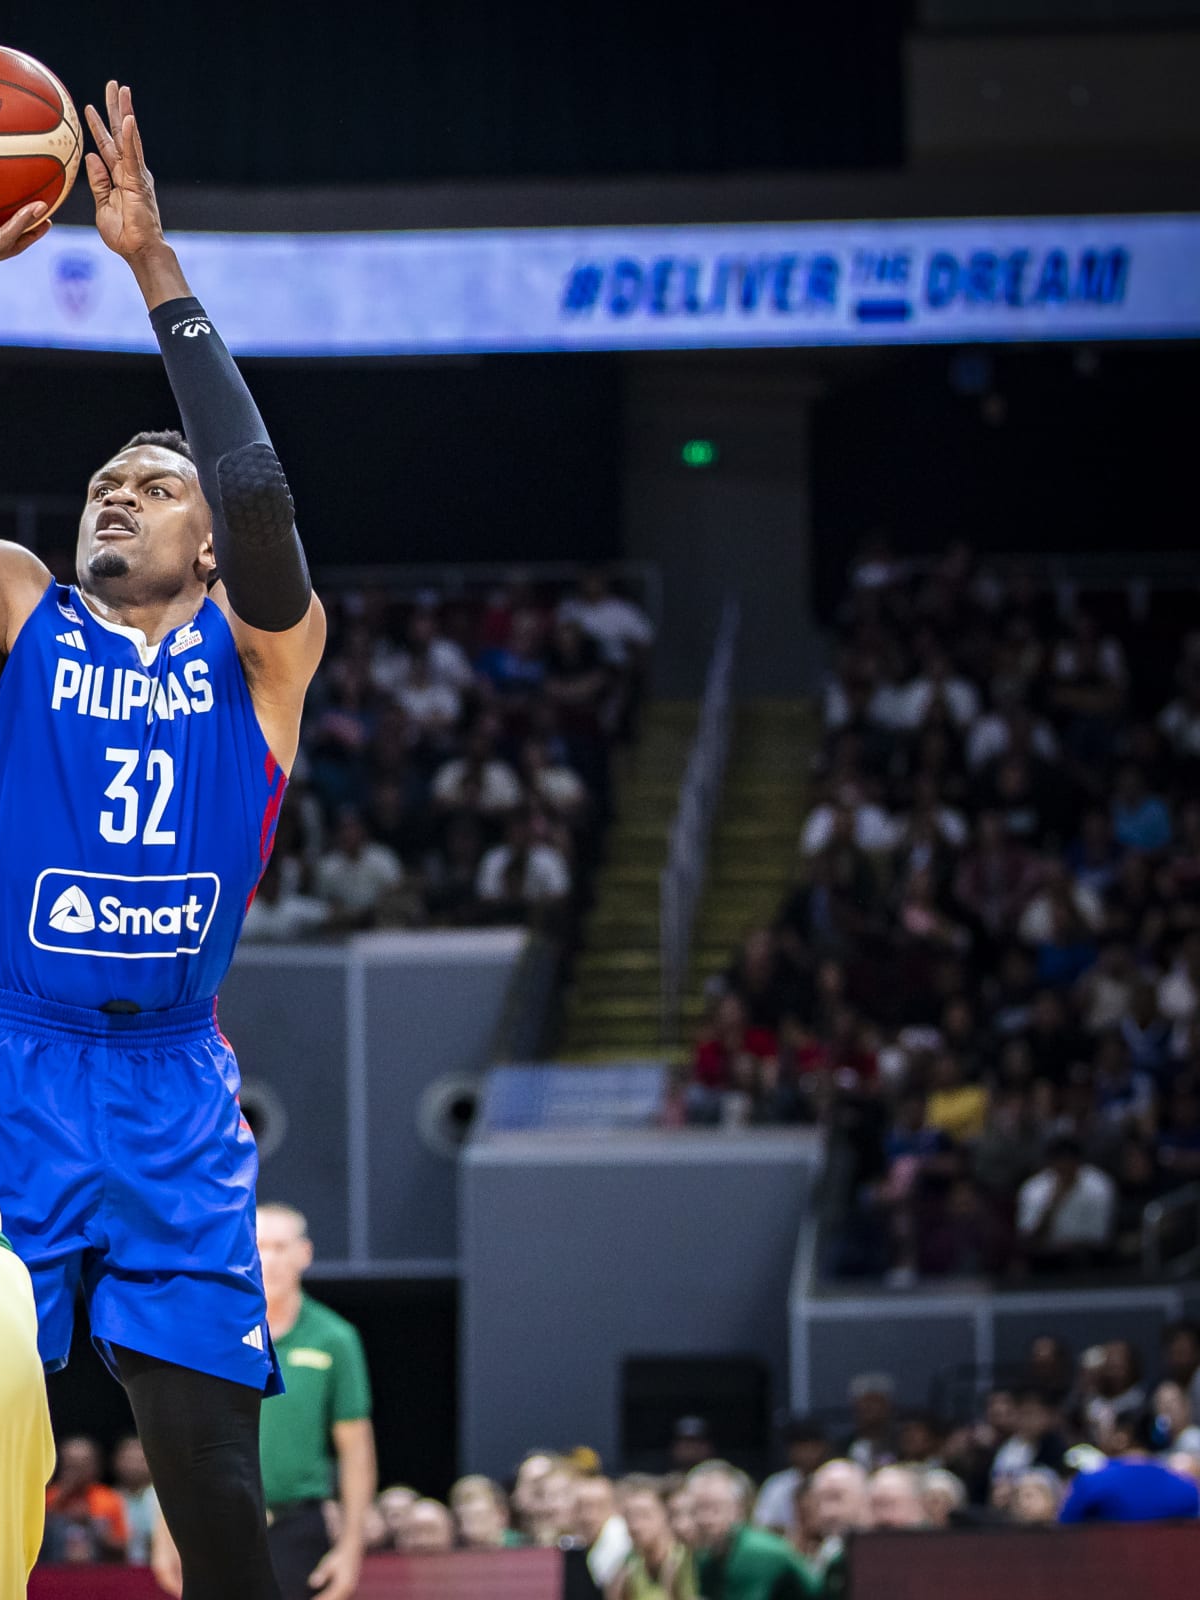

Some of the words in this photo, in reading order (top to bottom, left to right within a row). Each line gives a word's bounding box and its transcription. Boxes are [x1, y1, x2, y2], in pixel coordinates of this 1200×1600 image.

[563, 252, 840, 316] #DELIVER
[926, 246, 1130, 308] DREAM
[99, 747, 176, 845] 32
[99, 895, 203, 935] Smat
